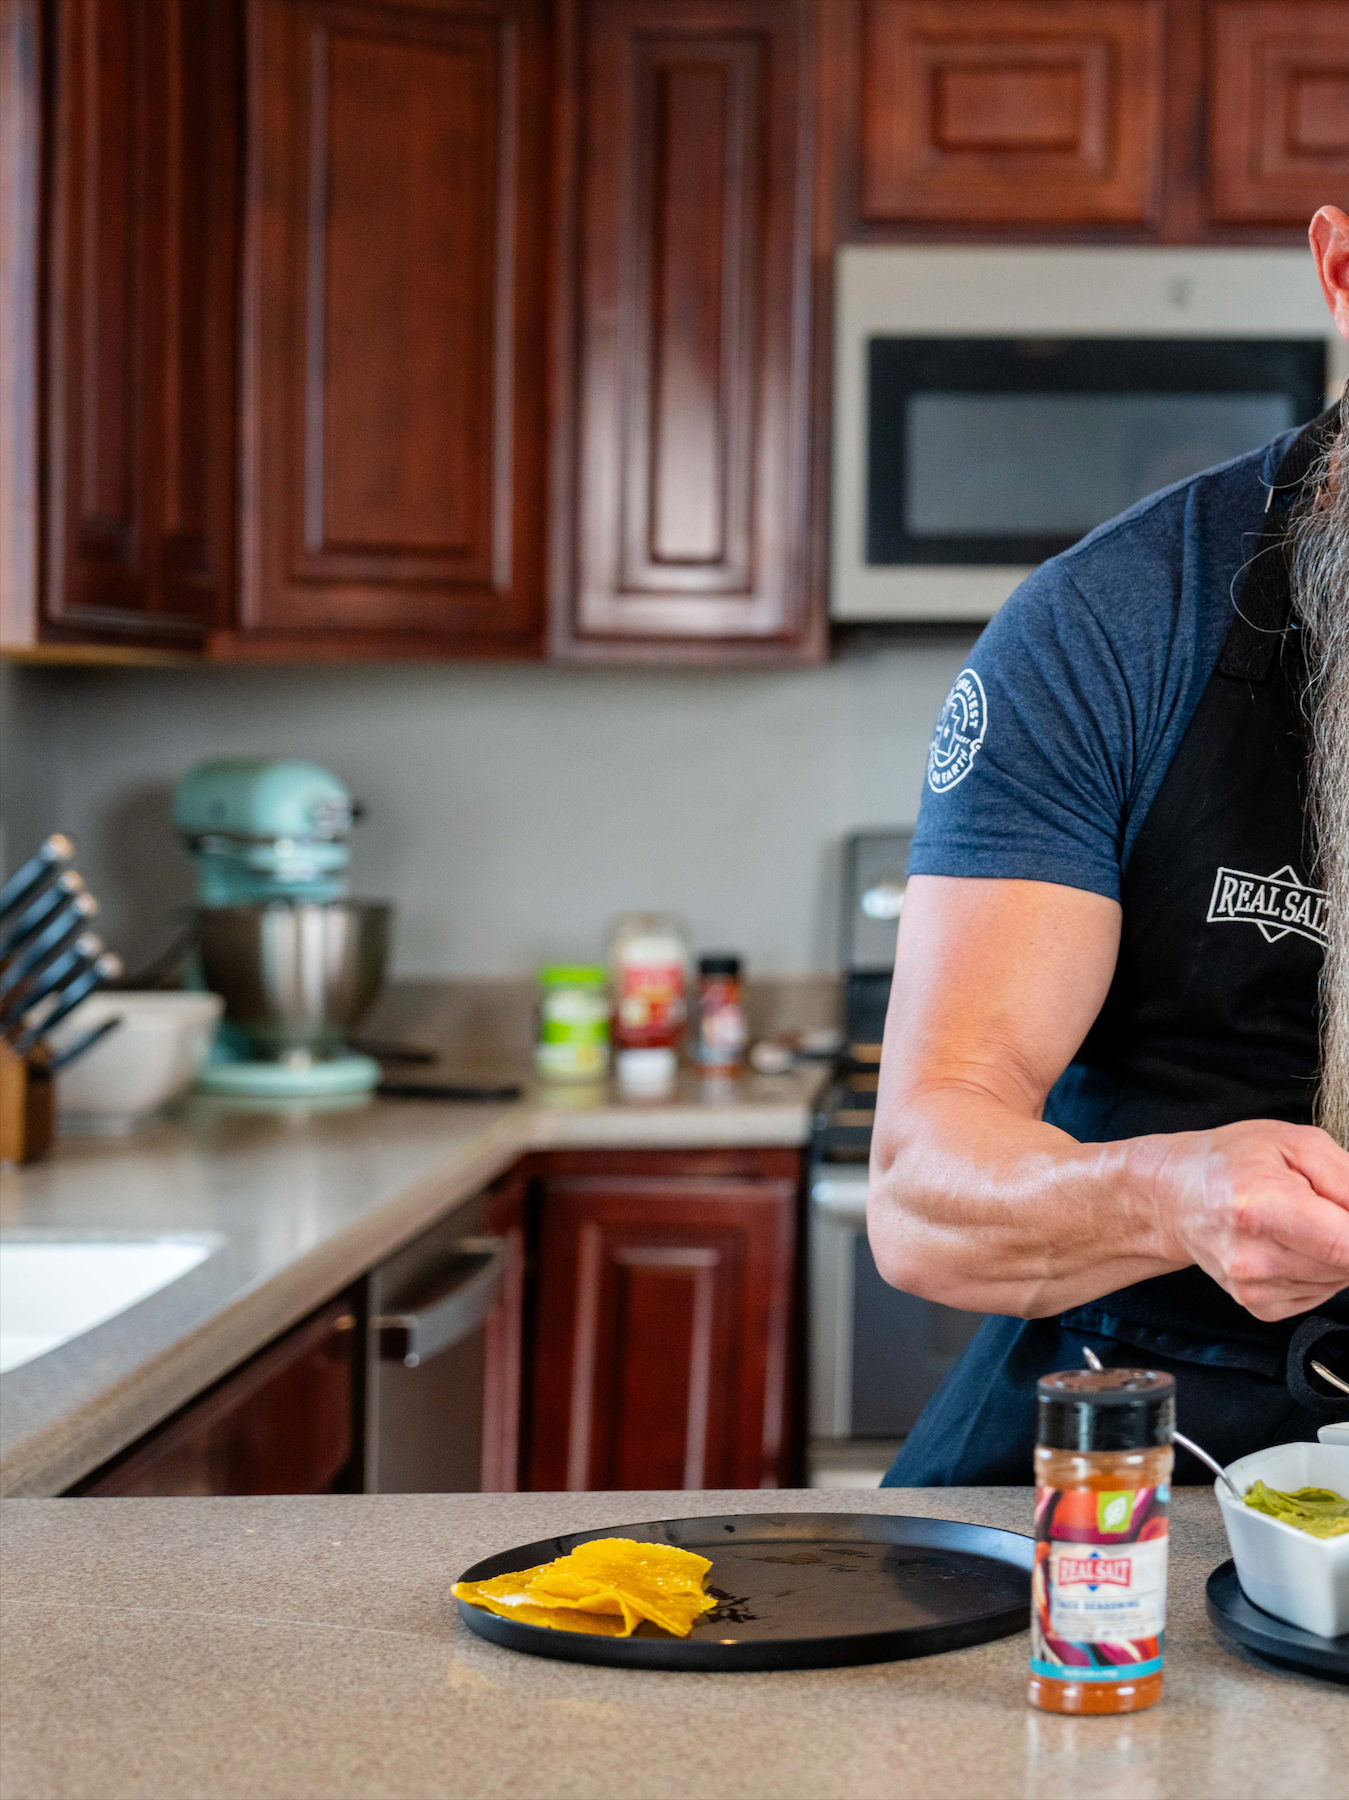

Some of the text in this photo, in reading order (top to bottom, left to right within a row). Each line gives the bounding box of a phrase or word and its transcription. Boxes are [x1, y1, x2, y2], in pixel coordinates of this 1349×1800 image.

[941, 748, 969, 785] EARTH
[1216, 876, 1280, 917] REAL
[1061, 1559, 1129, 1583] REAL SALT
